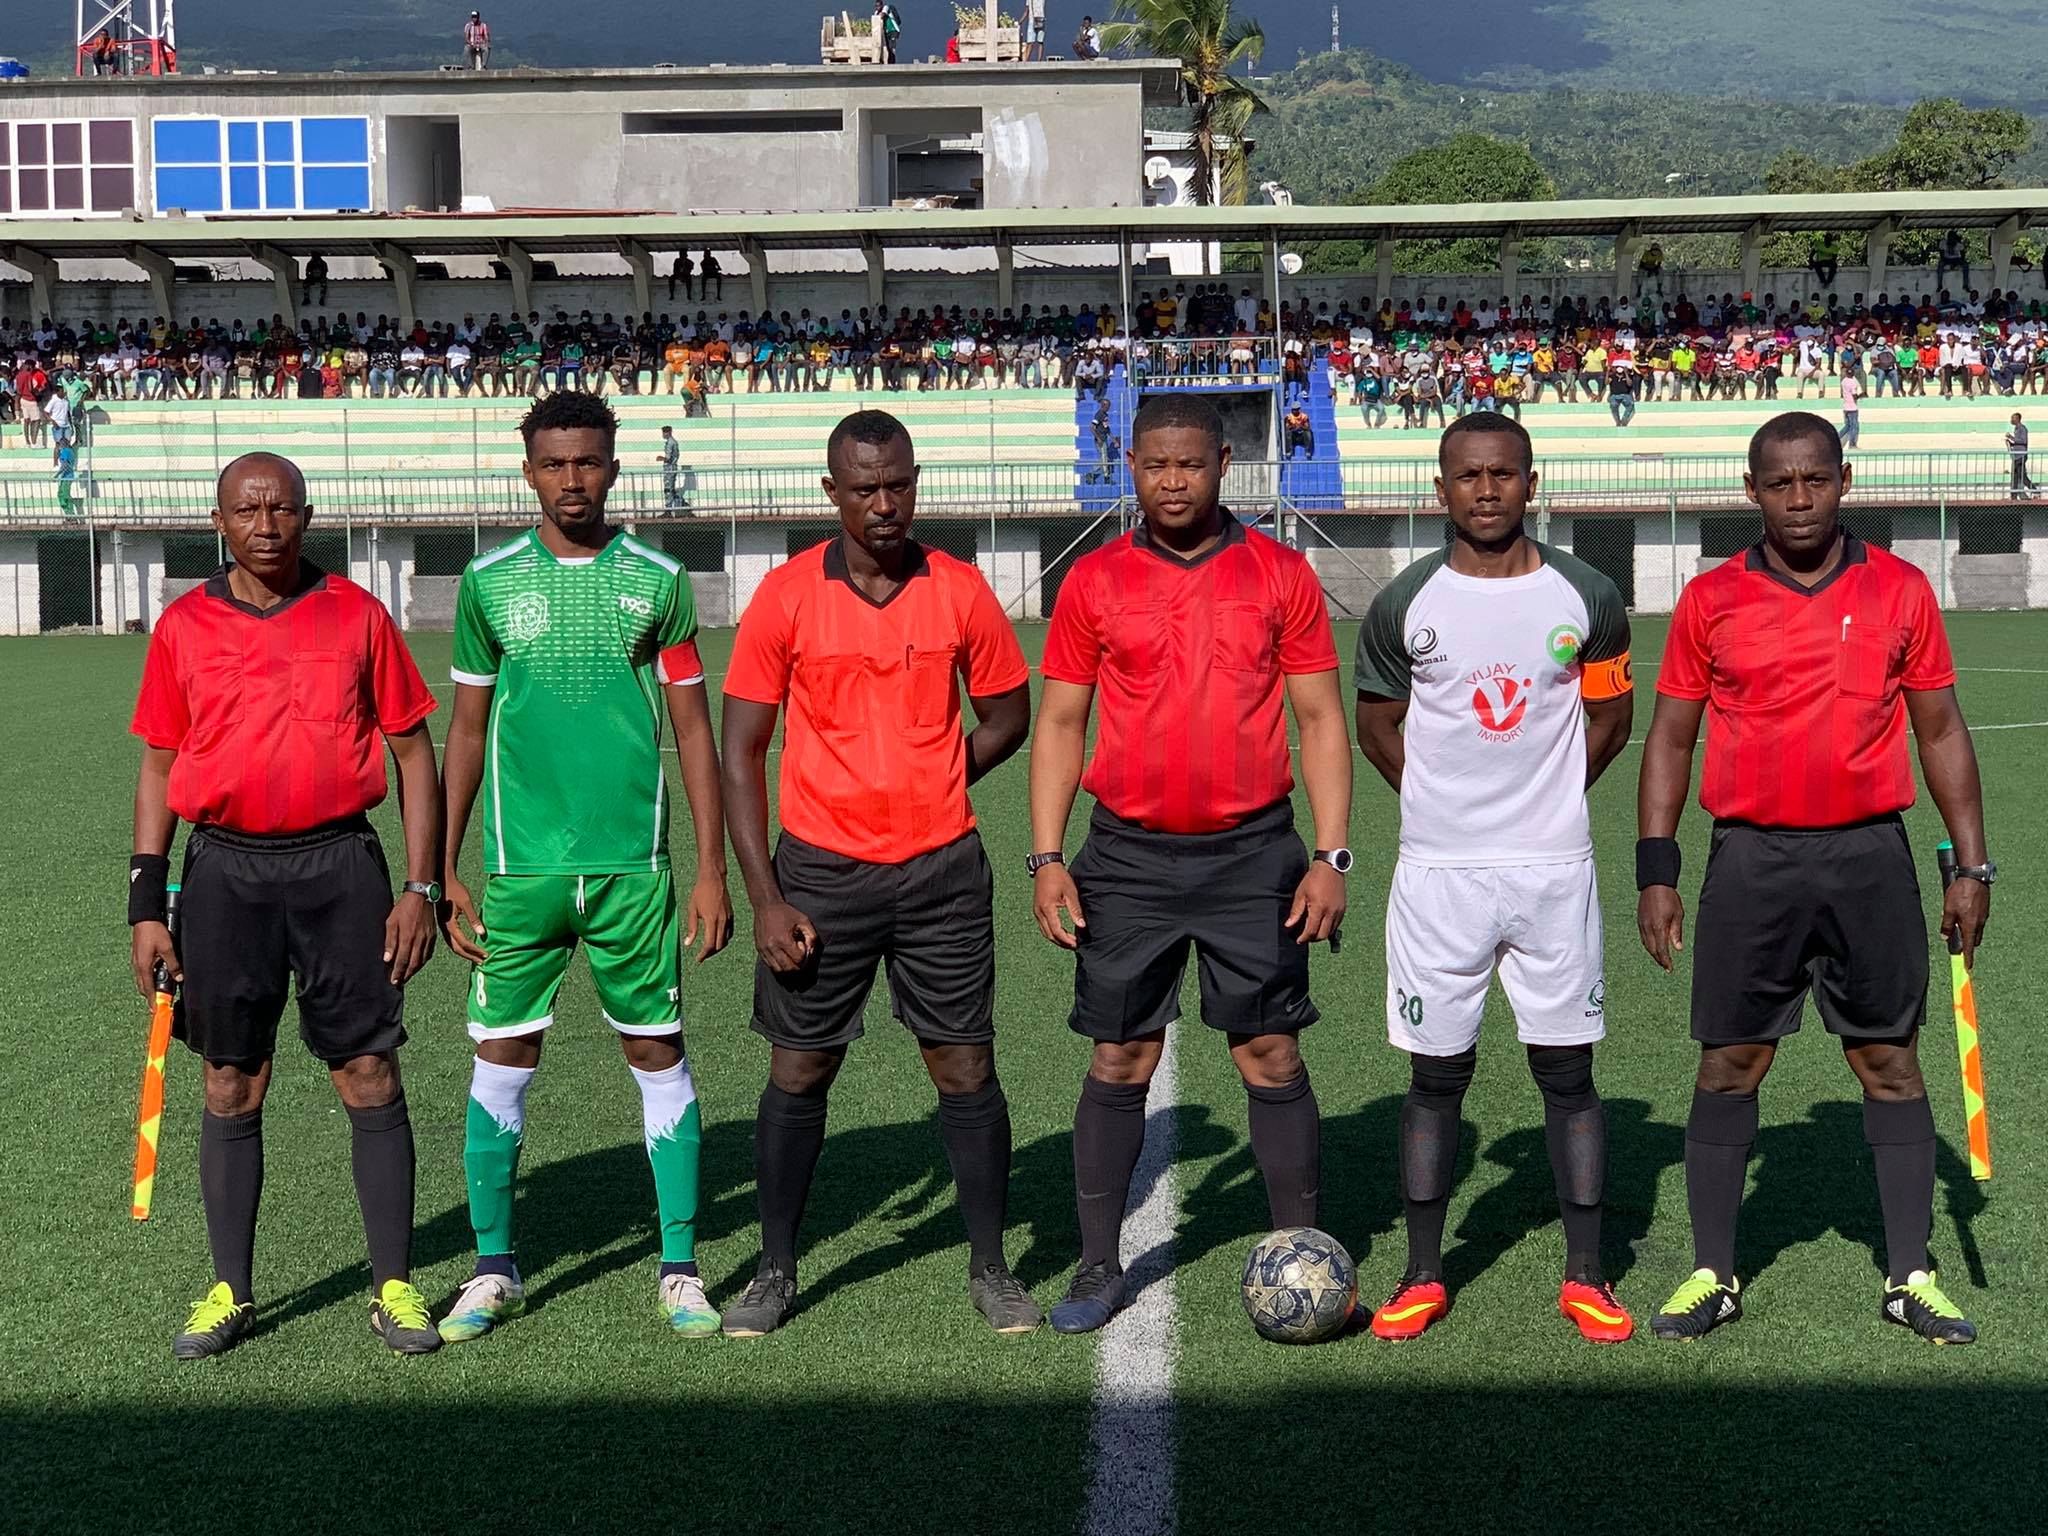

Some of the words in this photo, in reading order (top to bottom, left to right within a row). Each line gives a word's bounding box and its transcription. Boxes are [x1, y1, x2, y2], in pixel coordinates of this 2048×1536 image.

[1464, 662, 1517, 685] VIJAY
[1477, 725, 1524, 743] IMPORT
[476, 971, 487, 1008] 8
[1397, 987, 1423, 1026] 20
